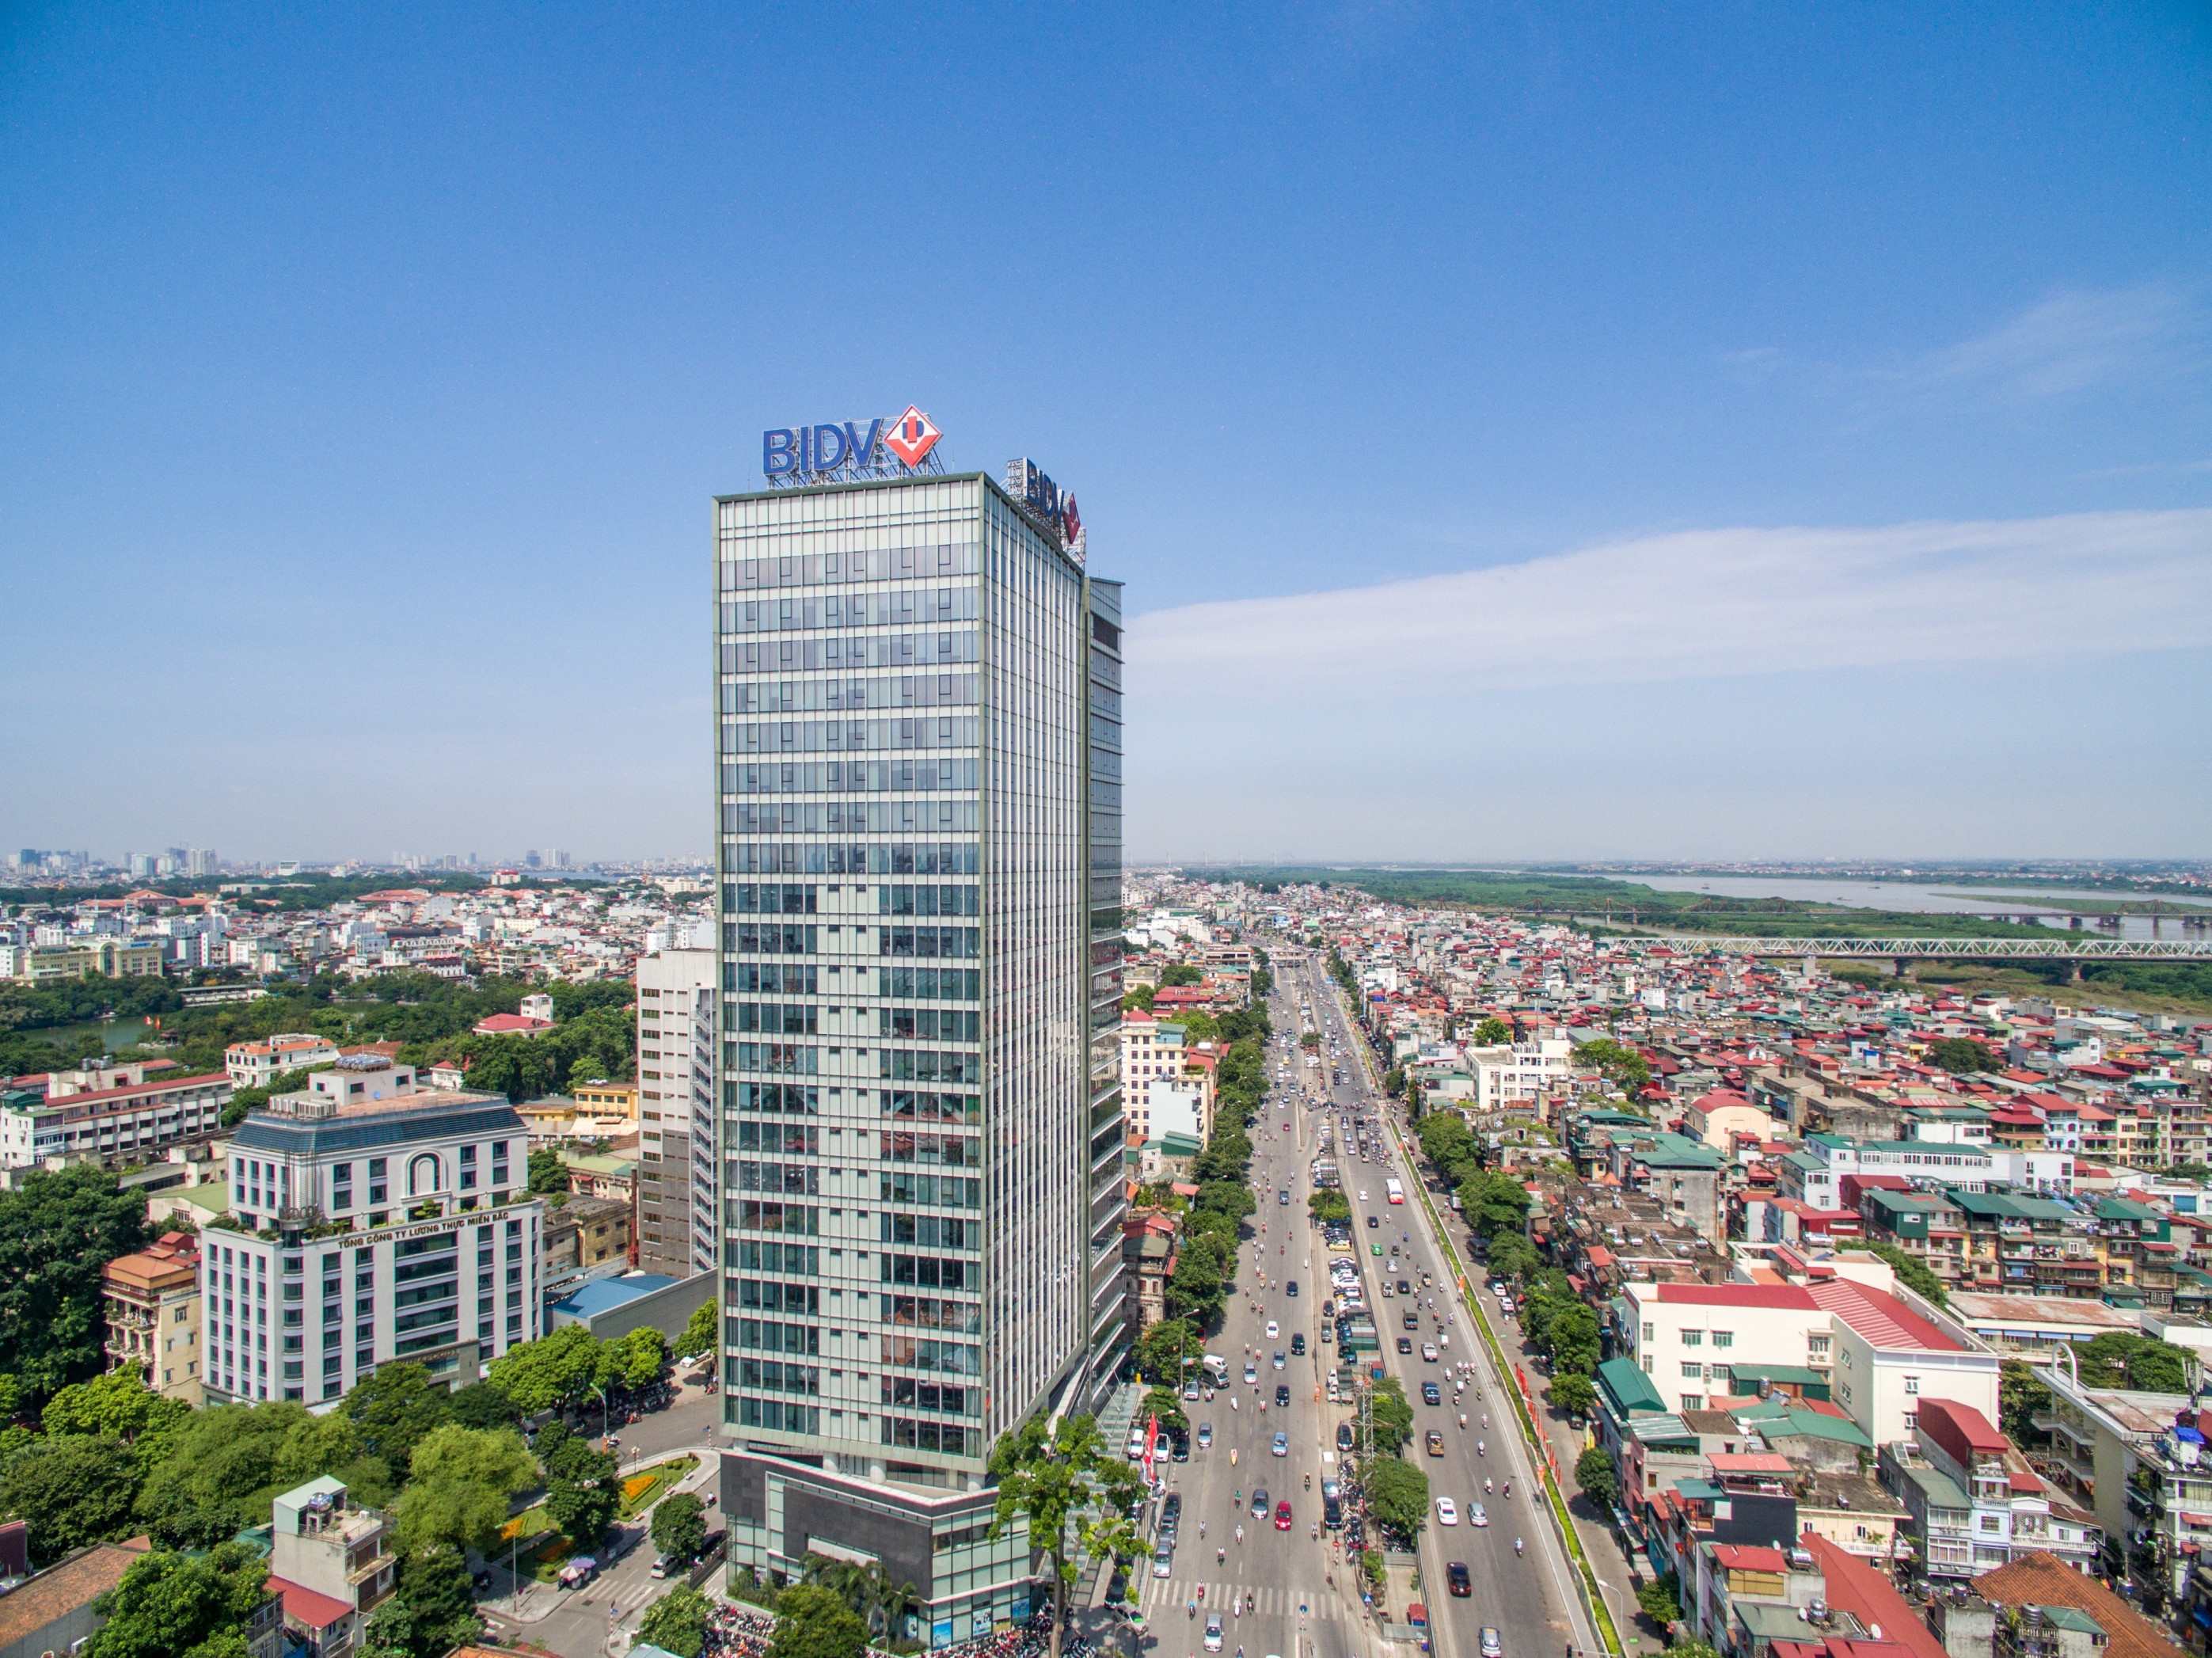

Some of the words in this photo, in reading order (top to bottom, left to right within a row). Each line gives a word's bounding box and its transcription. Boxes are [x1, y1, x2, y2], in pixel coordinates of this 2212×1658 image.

[763, 418, 883, 475] BIDV
[1026, 458, 1066, 527] BIDV
[367, 1233, 393, 1244] CÔNG
[395, 1230, 407, 1239] TY
